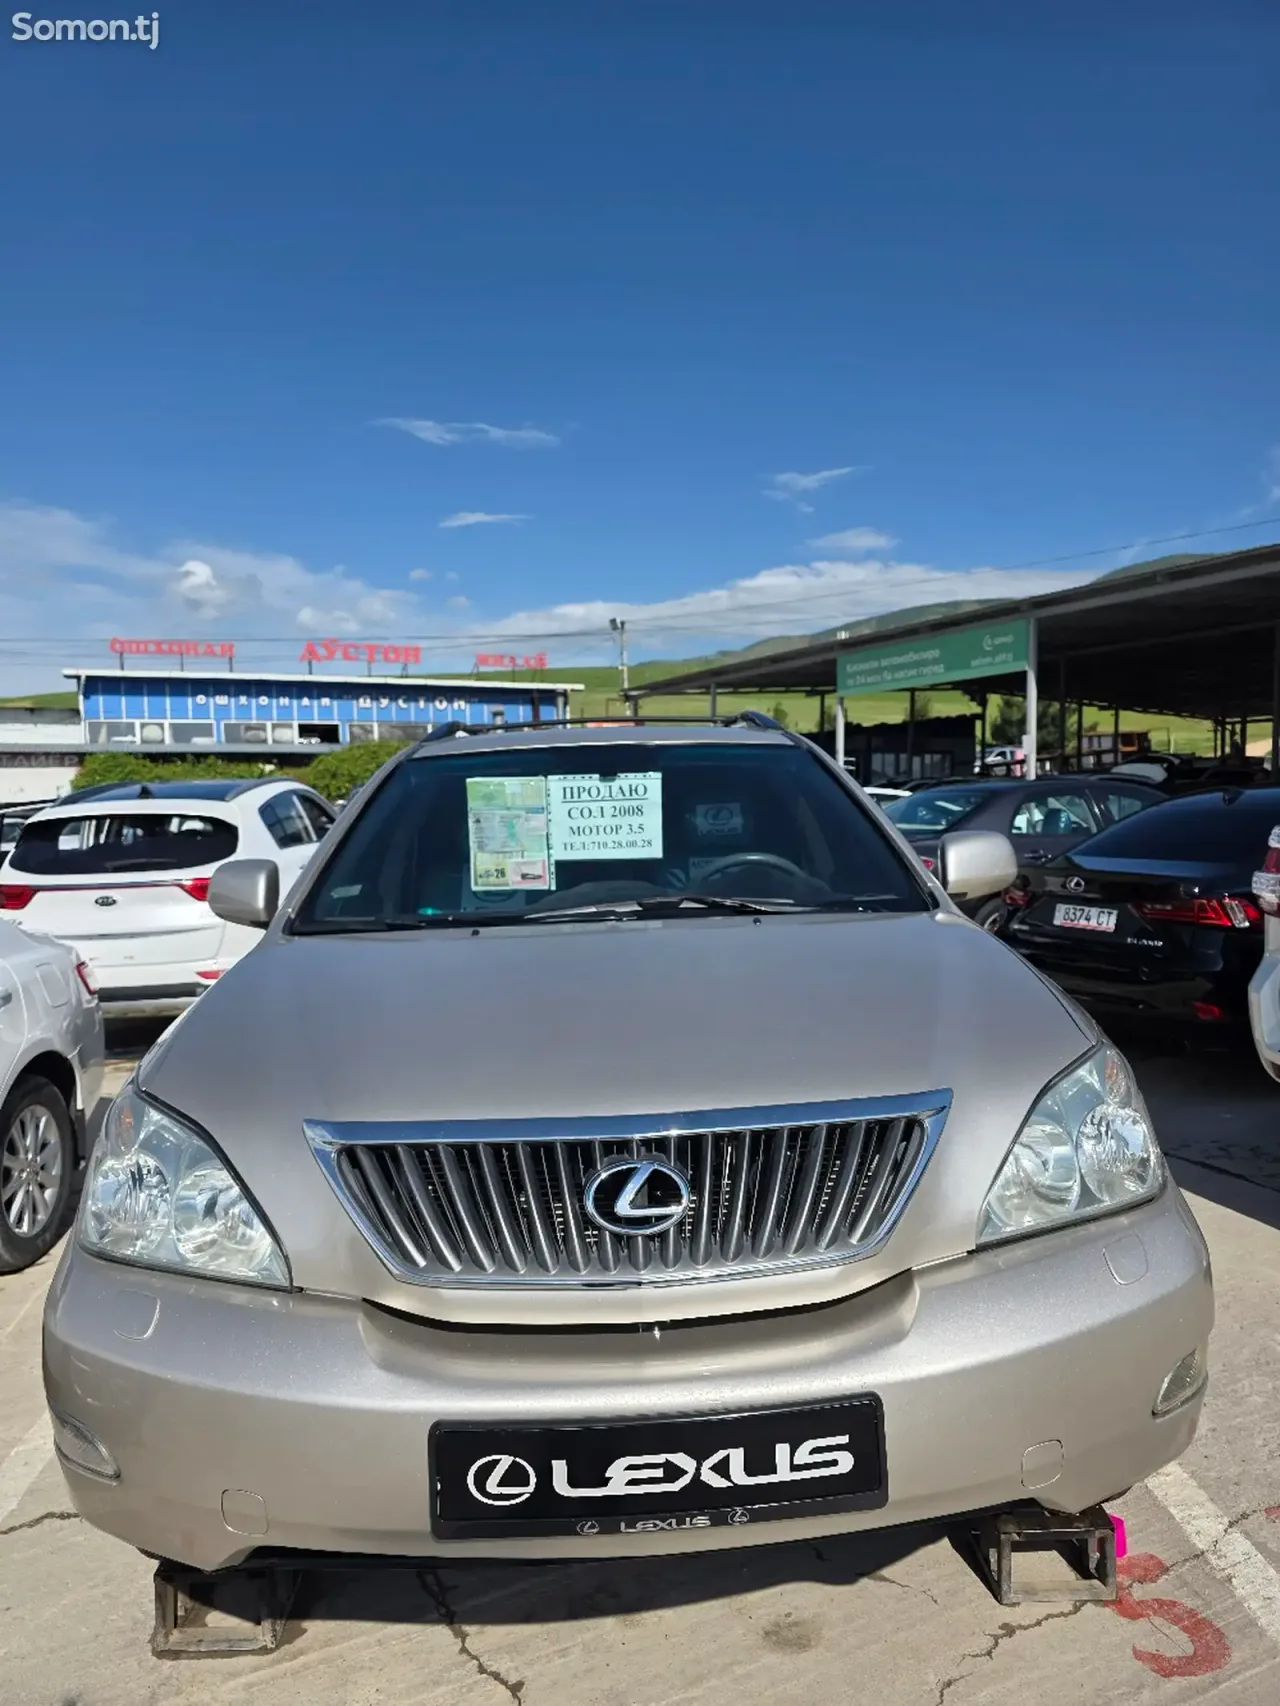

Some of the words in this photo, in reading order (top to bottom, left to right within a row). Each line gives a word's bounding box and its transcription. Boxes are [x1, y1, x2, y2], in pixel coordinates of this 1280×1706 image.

[562, 784, 648, 801] ПРОДАЮ
[567, 806, 605, 820] СОЛ
[610, 805, 644, 818] 2008
[569, 824, 622, 837] МОТОР
[627, 823, 645, 836] 3.5
[1063, 906, 1092, 925] 8374
[1096, 909, 1114, 926] CT
[552, 1434, 856, 1497] LEXUS
[620, 1515, 711, 1532] LEXUS
